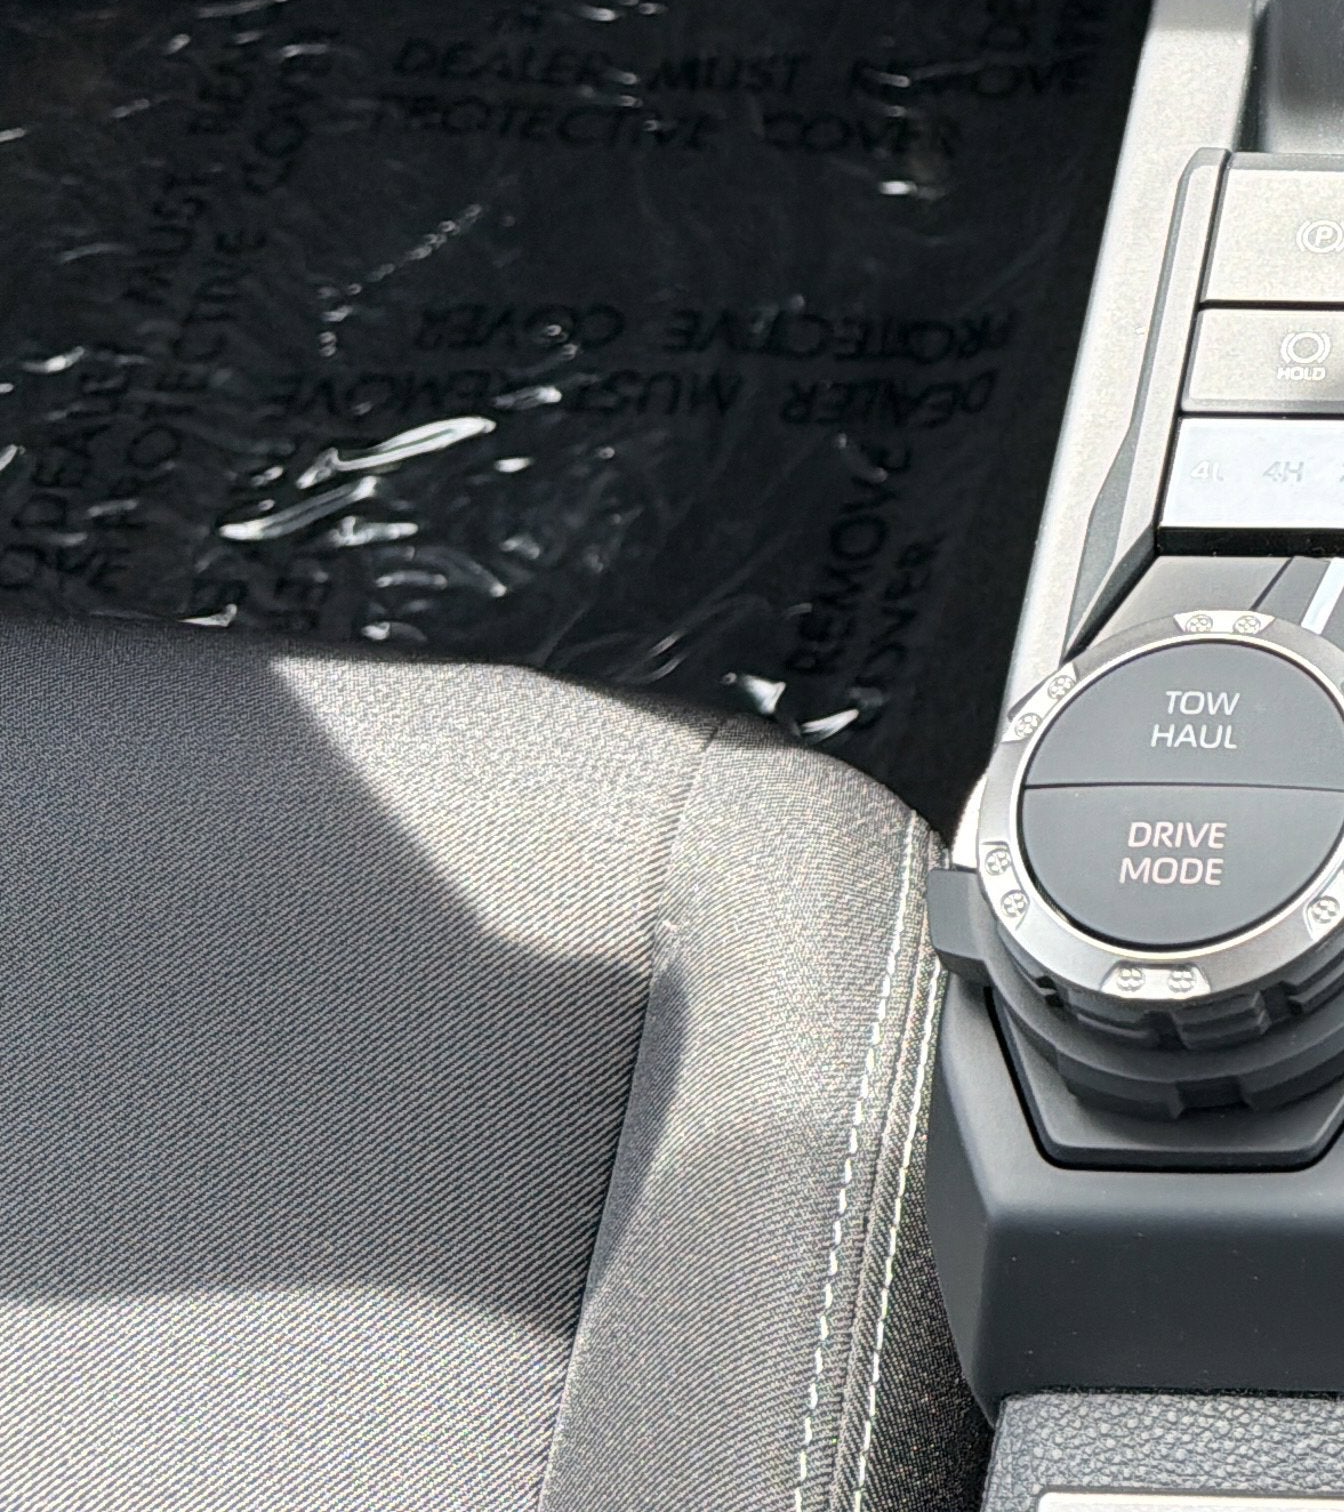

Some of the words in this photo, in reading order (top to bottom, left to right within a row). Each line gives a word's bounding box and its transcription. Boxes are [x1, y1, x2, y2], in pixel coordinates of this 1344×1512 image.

[1276, 366, 1327, 382] HOLD
[1261, 460, 1305, 484] 4H
[1165, 690, 1241, 716] TOW
[1150, 723, 1238, 749] HAUL
[1127, 821, 1228, 849] DRIVE
[1118, 857, 1224, 886] MODE
